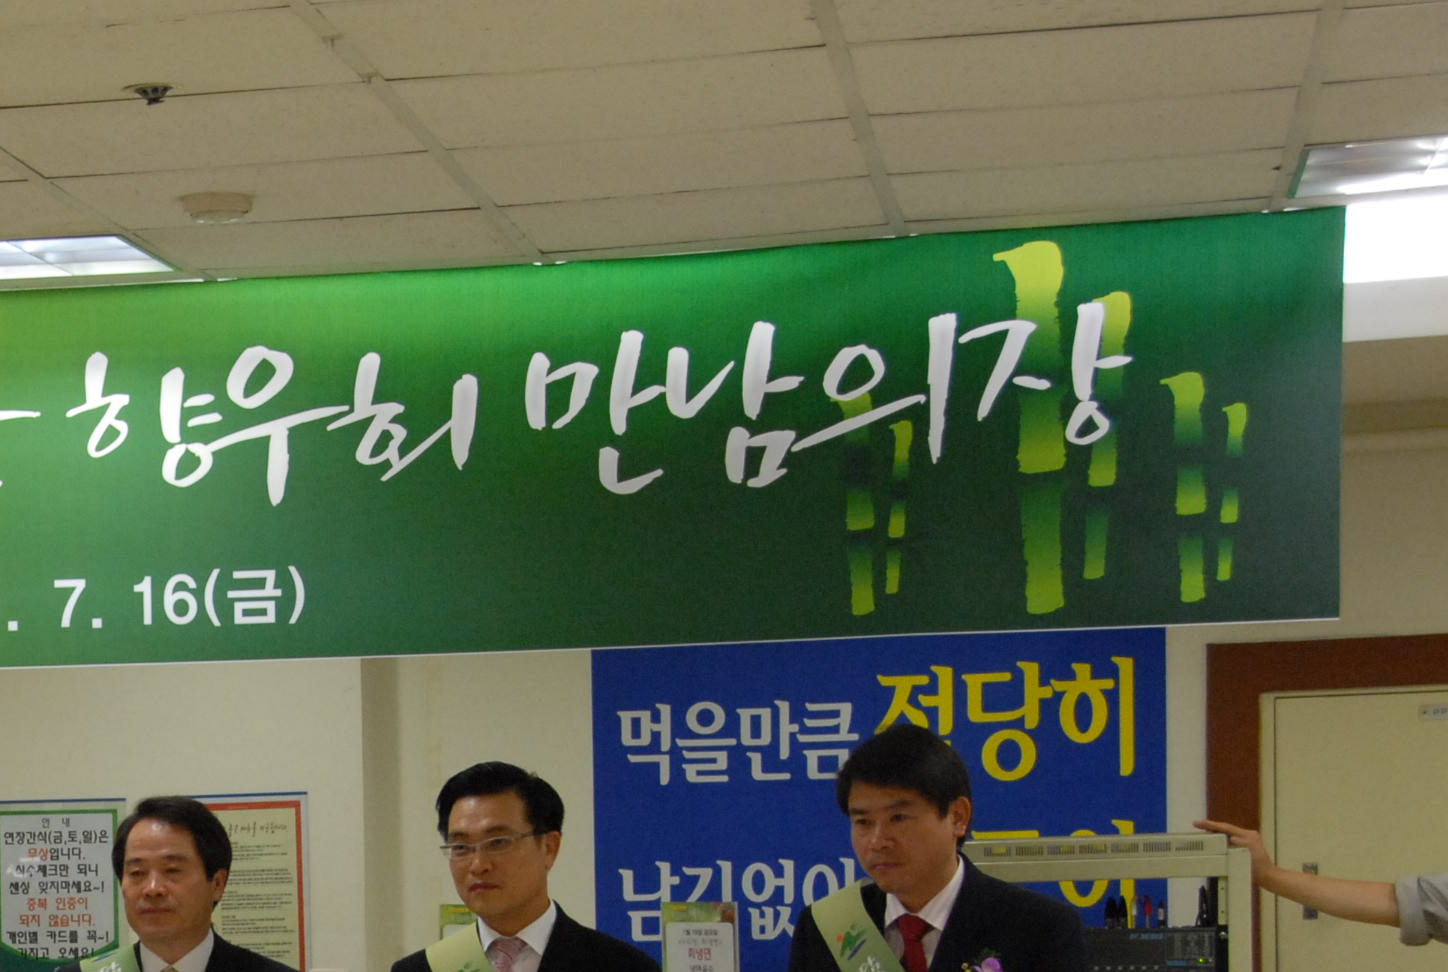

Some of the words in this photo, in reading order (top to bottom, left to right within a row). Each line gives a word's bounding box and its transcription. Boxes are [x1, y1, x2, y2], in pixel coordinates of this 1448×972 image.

[66, 345, 480, 507] 향우회
[53, 578, 104, 631] 7.
[132, 565, 307, 628] 16(금)
[616, 698, 860, 787] 먹을만큼
